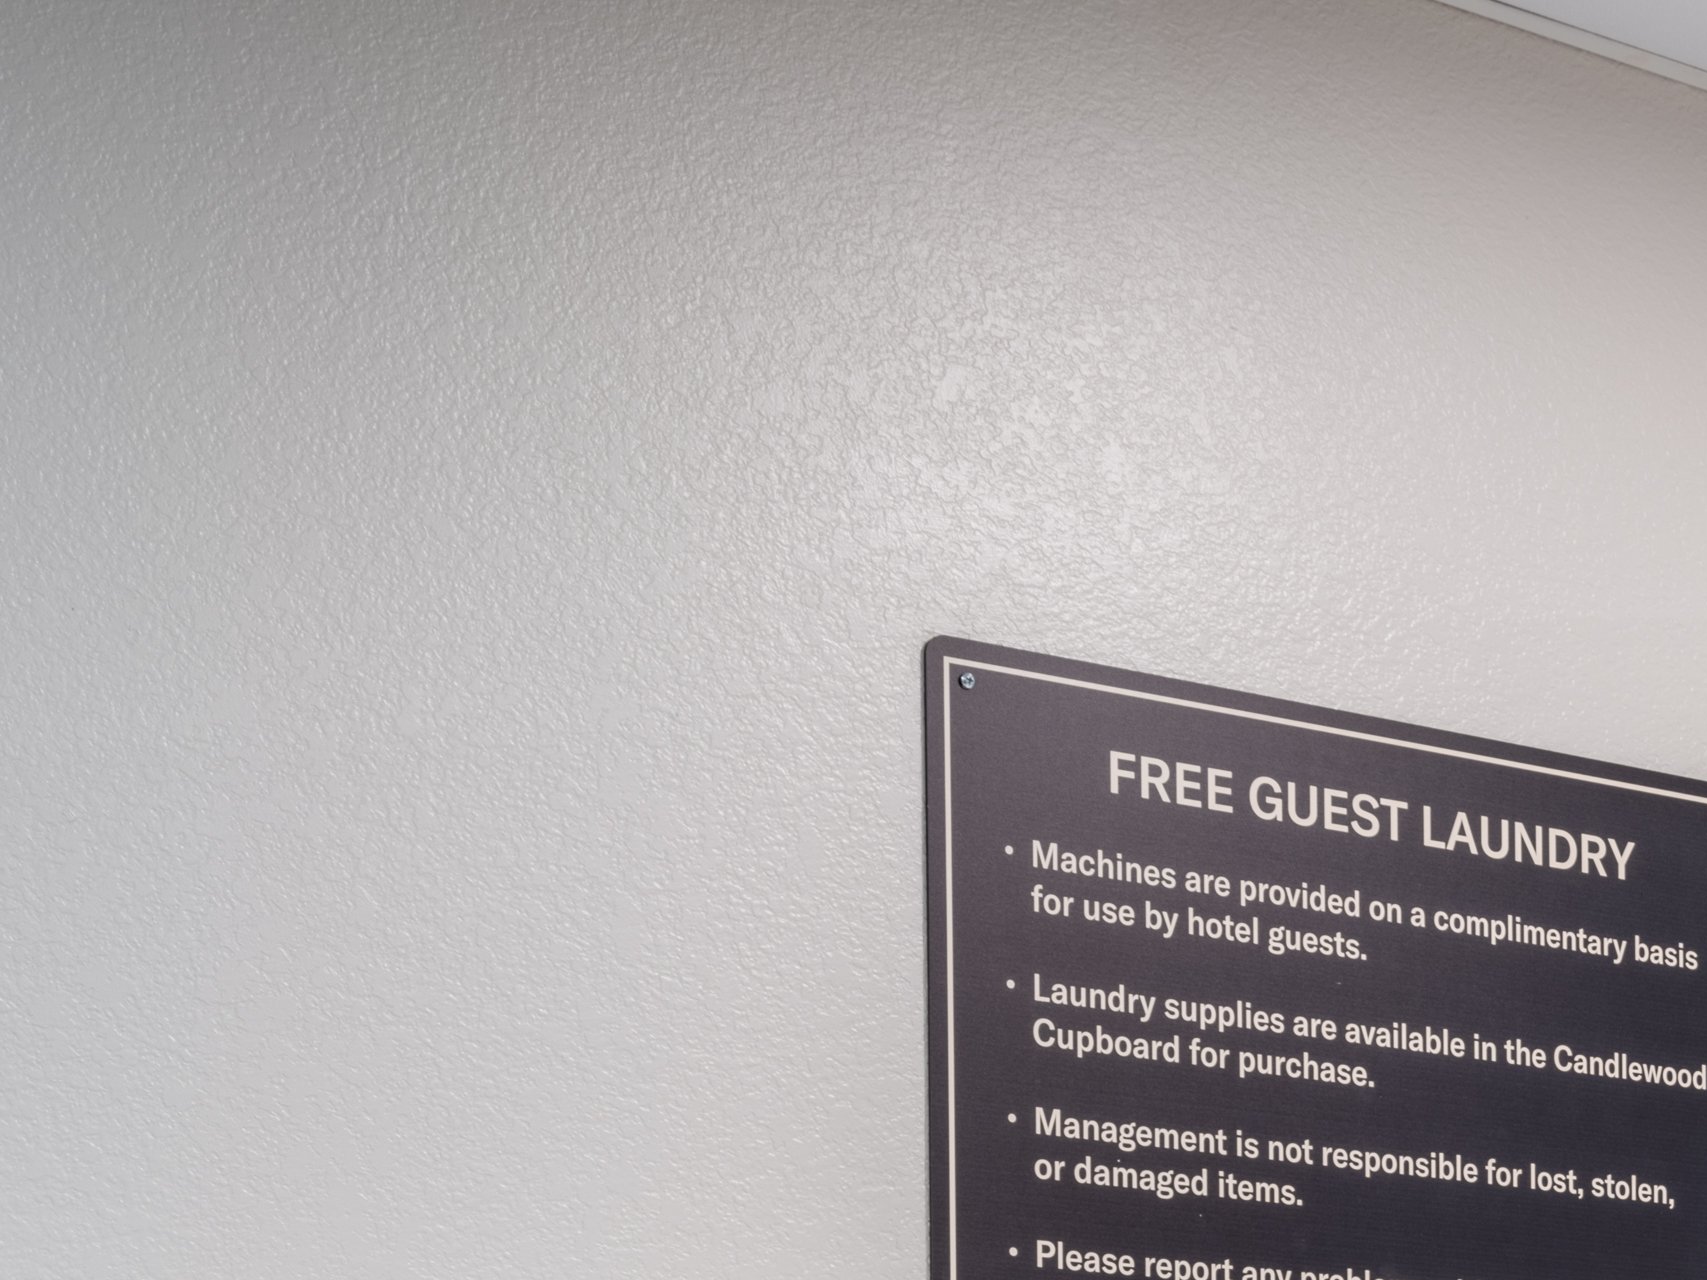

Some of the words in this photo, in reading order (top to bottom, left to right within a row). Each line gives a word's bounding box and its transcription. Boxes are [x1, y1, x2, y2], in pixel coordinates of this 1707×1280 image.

[1110, 750, 1233, 813] FREE
[1249, 776, 1408, 841] GUEST
[1423, 805, 1635, 880] LAUNDRY
[1031, 884, 1074, 917] for
[1084, 900, 1135, 926] use
[1145, 901, 1179, 938] by
[1188, 907, 1258, 944] hotel
[1268, 926, 1367, 960] guests.
[1032, 840, 1176, 889] Machines
[1185, 872, 1230, 897] are
[1240, 880, 1360, 917] provided
[1369, 901, 1402, 924] on
[1411, 907, 1425, 927] a
[1434, 911, 1627, 964] complimentary
[1635, 935, 1698, 970] basis
[1033, 1018, 1179, 1063] Cupboard
[1189, 1038, 1230, 1069] for
[1239, 1052, 1374, 1087] purchase.
[1034, 973, 1156, 1022] Laundry
[1165, 999, 1284, 1033] supplies
[1293, 1016, 1337, 1040] are
[1345, 1022, 1465, 1057] available
[1474, 1033, 1496, 1062] in
[1504, 1039, 1546, 1068] the
[1554, 1045, 1706, 1090] Candlewood
[1034, 1159, 1065, 1181] or
[1074, 1156, 1207, 1199] damaged
[1219, 1174, 1302, 1206] items.
[1036, 1107, 1227, 1155] Management
[1237, 1130, 1259, 1158] is
[1269, 1139, 1313, 1165] not
[1323, 1147, 1478, 1183] responsible
[1485, 1158, 1522, 1187] for
[1531, 1163, 1583, 1199] lost,
[1592, 1174, 1674, 1209] stolen,
[1037, 1240, 1135, 1275] Please
